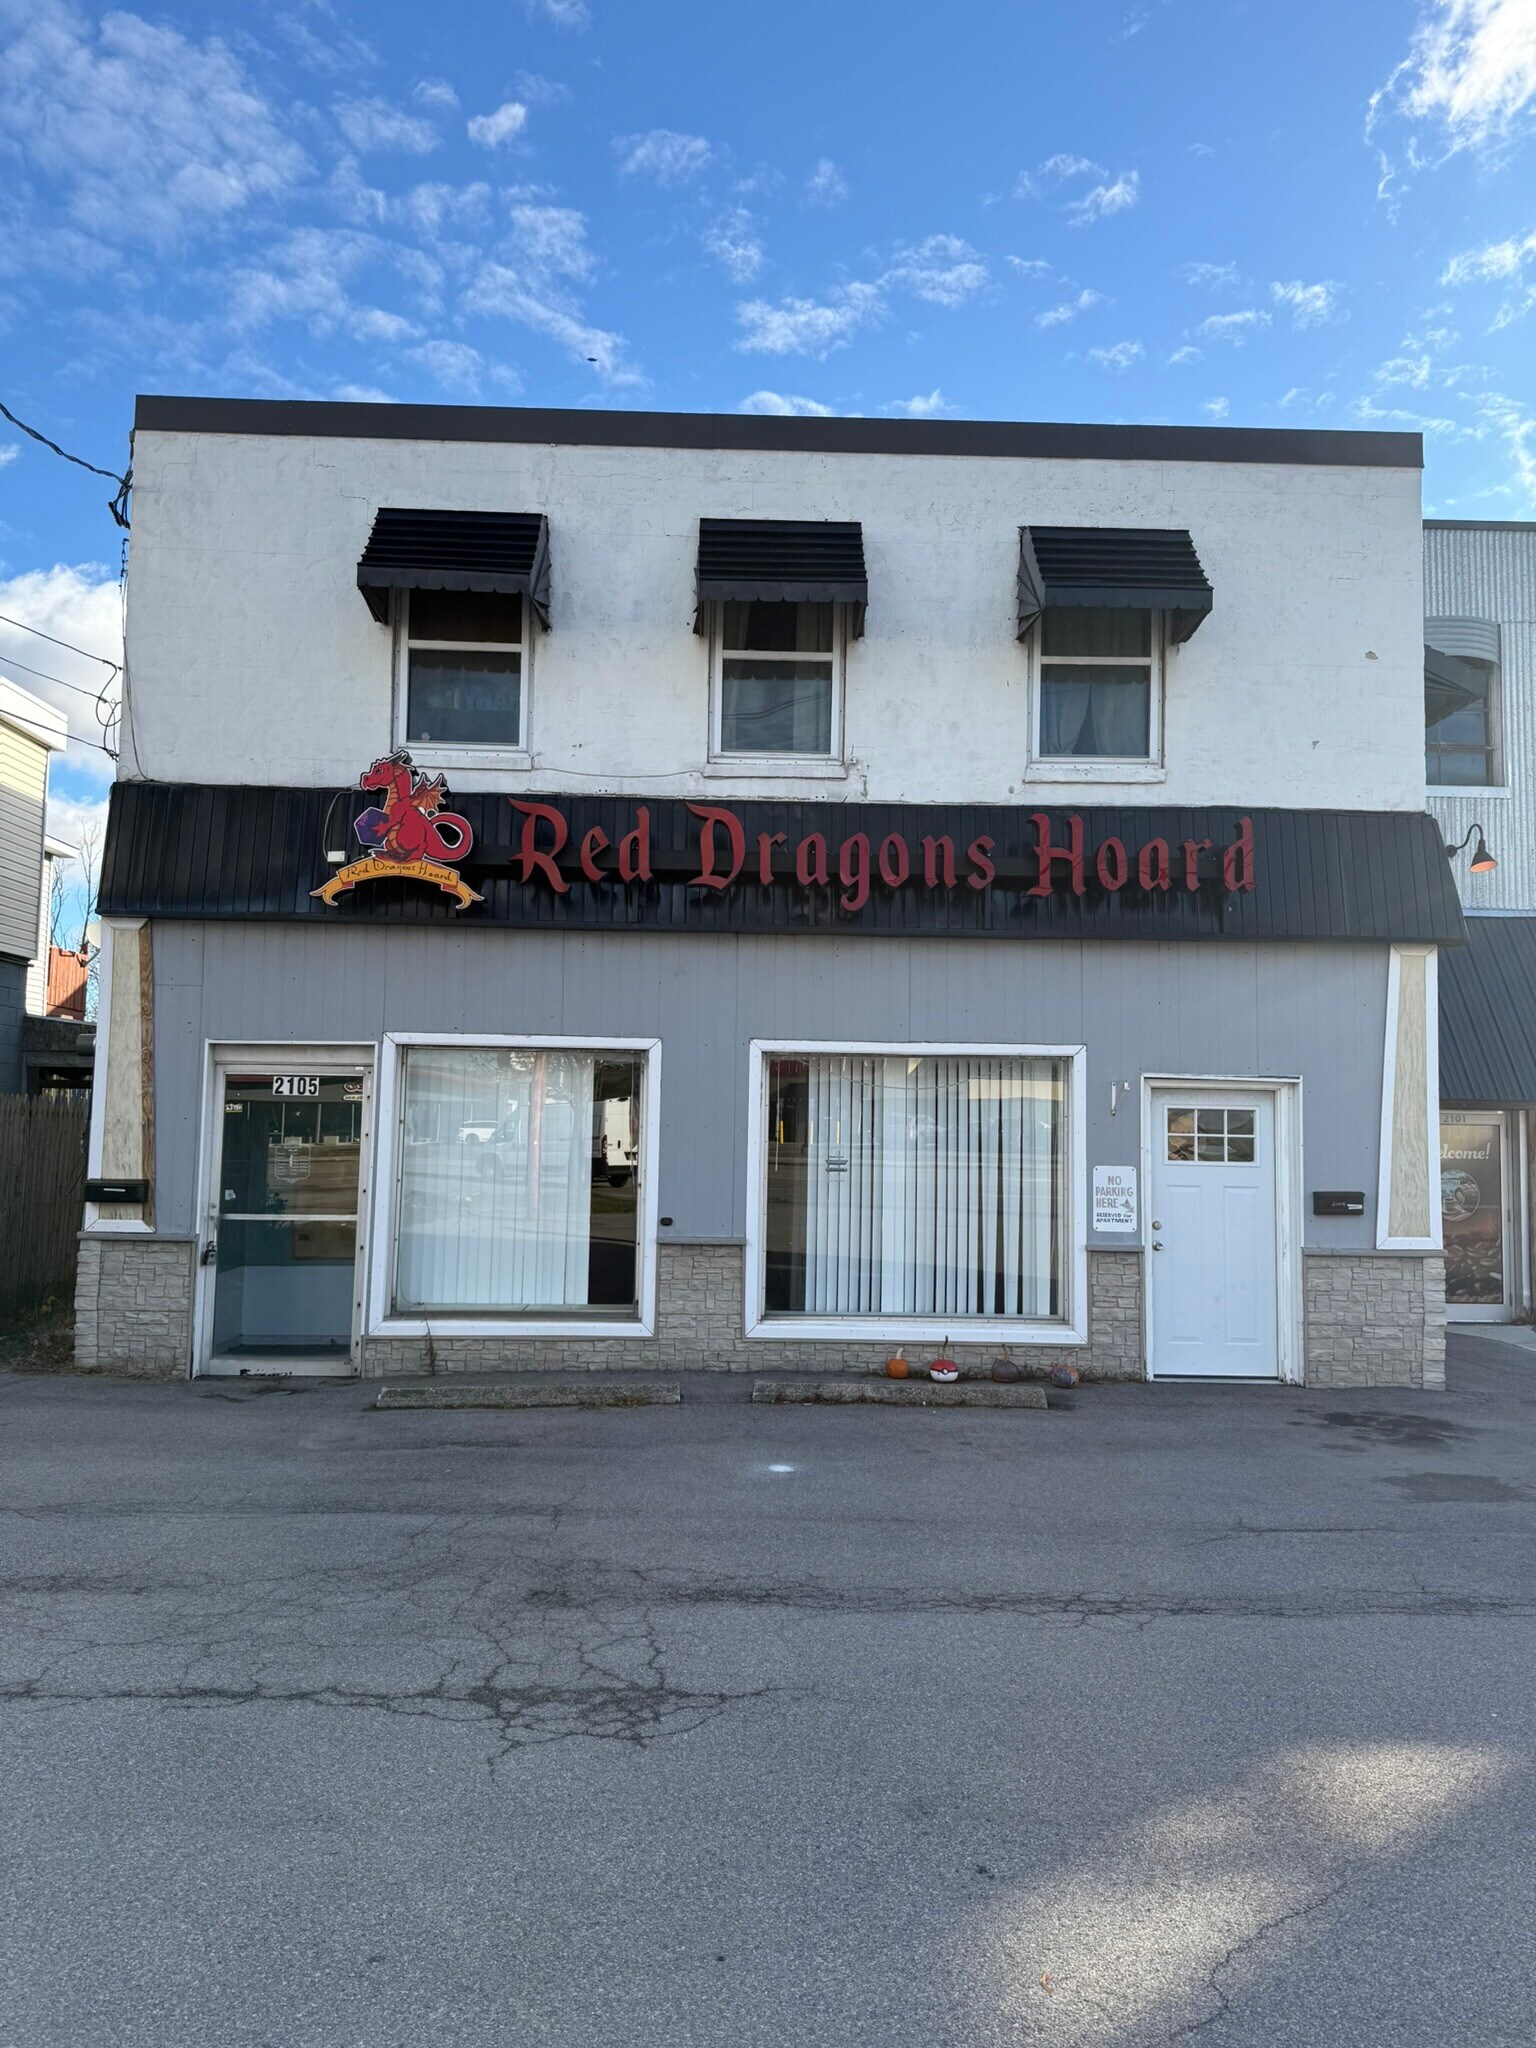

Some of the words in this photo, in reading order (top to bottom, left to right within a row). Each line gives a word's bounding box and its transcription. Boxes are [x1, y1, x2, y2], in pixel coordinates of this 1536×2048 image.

[508, 798, 654, 893] Red
[686, 801, 997, 911] Dragons
[1025, 813, 1257, 897] Hoard
[347, 863, 370, 878] Red
[373, 859, 416, 874] Dragons
[418, 861, 452, 881] Hoard
[274, 1077, 318, 1095] 2105
[1443, 1114, 1466, 1123] 2101
[1440, 1142, 1491, 1160] elcome!
[1107, 1175, 1122, 1186] NO
[1095, 1186, 1134, 1197] PARKING
[1096, 1197, 1119, 1208] HERE
